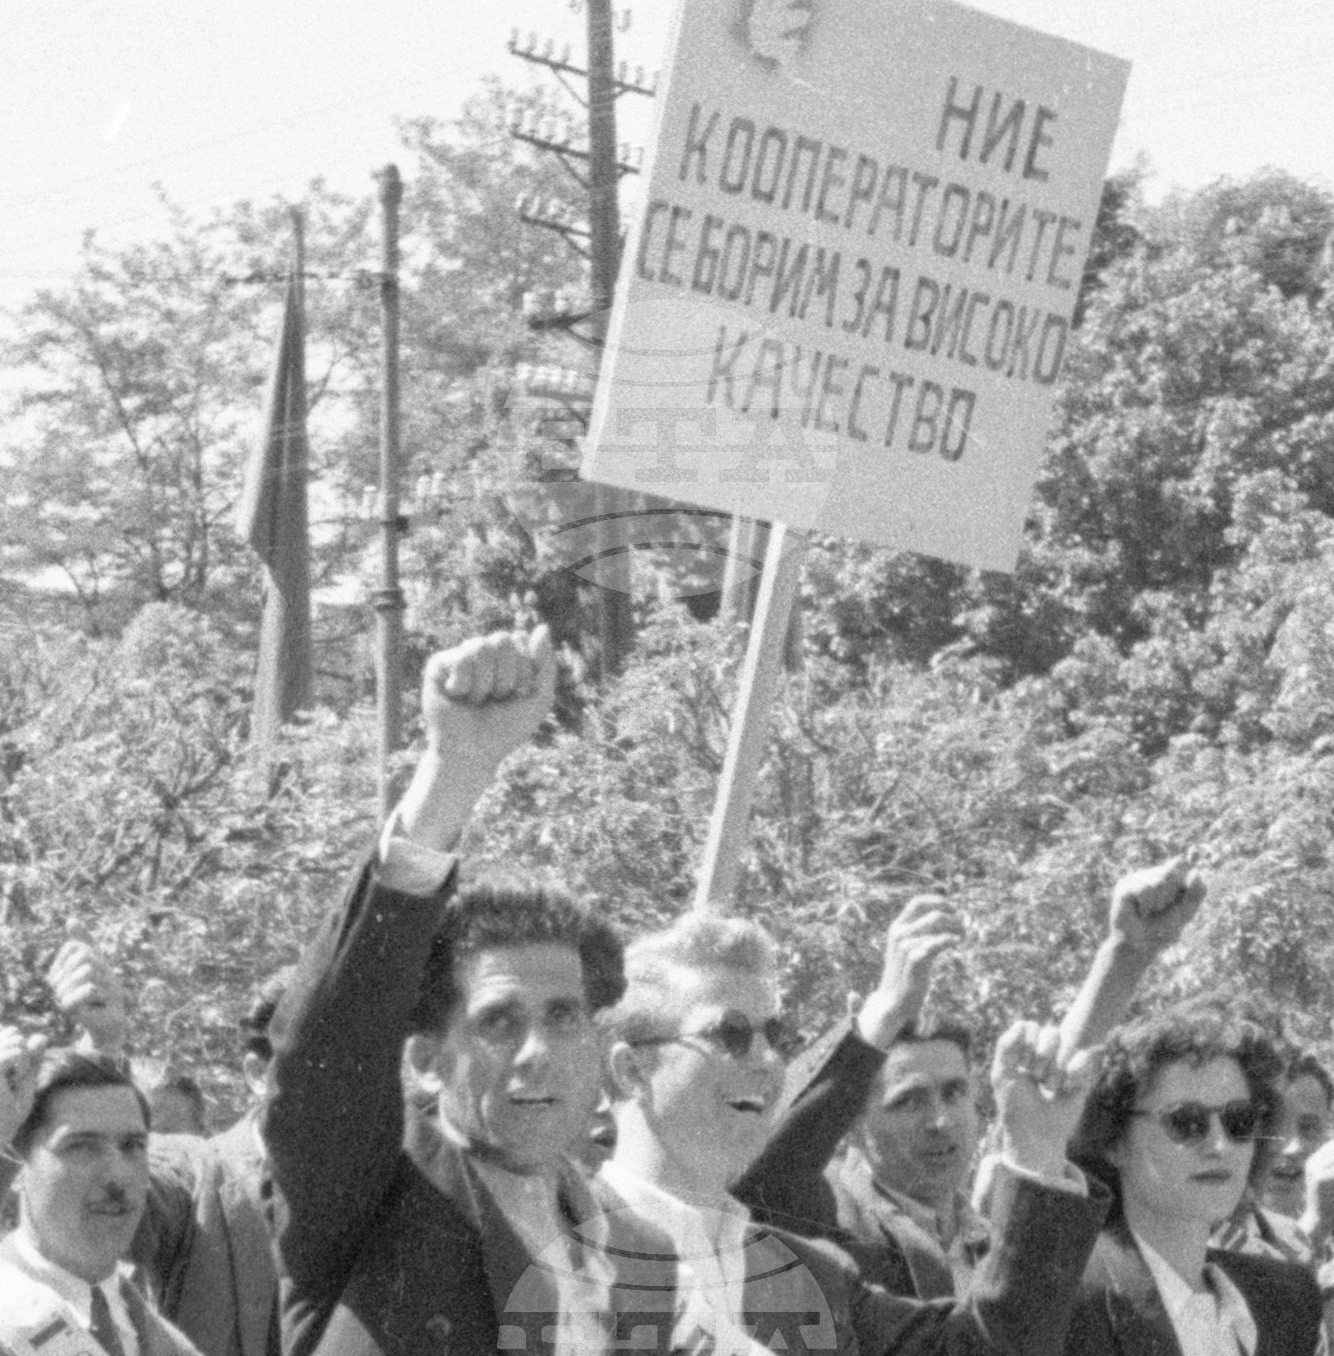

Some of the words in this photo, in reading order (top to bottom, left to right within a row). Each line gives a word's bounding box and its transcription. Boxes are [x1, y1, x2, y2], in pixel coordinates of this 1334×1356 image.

[678, 104, 1081, 290] КООПЕРАТОРИТЕ
[935, 76, 1058, 183] НИЕ
[636, 200, 692, 283] СЕ
[692, 214, 841, 327] БОРИМ
[843, 258, 901, 342] ЗА
[904, 276, 1068, 386] ВИСОКО
[707, 326, 976, 461] КАЧЕСТВО
